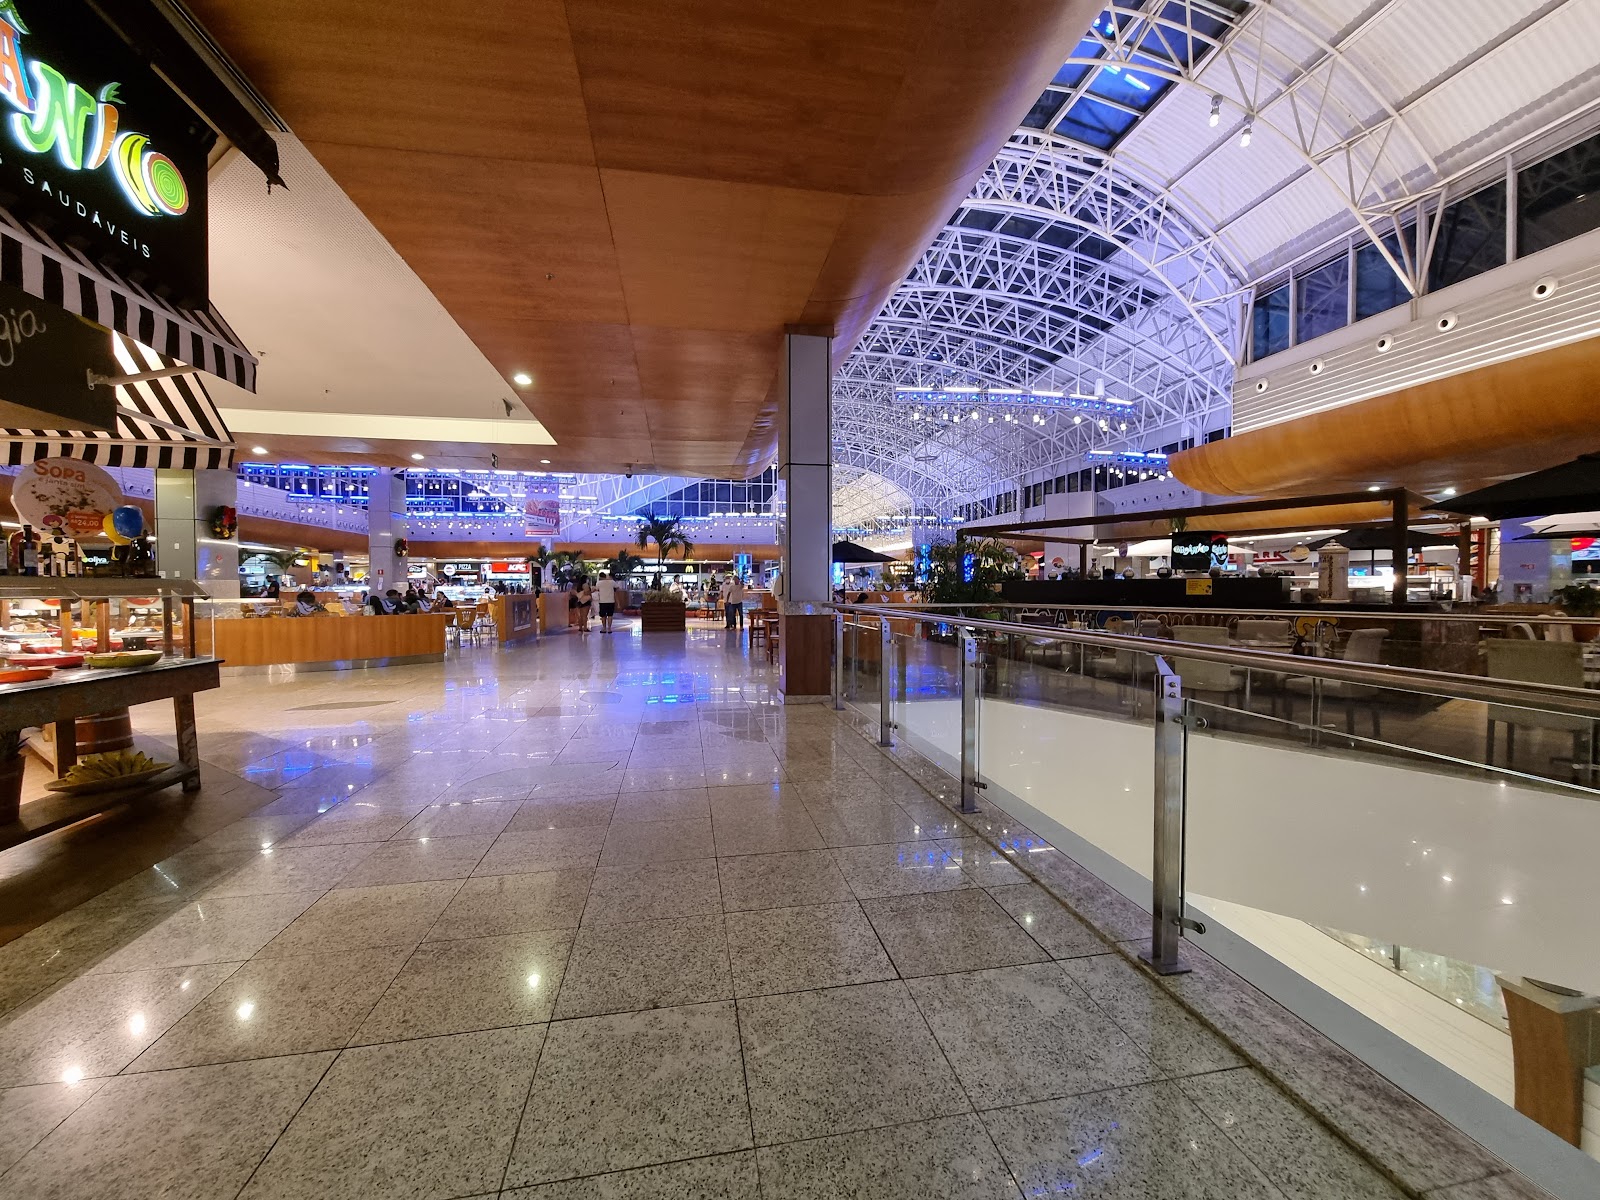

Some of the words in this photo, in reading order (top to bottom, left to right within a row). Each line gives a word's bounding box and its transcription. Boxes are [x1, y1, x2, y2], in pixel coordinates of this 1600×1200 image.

[23, 167, 151, 259] SAUDÁVEIS
[33, 460, 86, 483] Sopa
[507, 563, 526, 572] KFC
